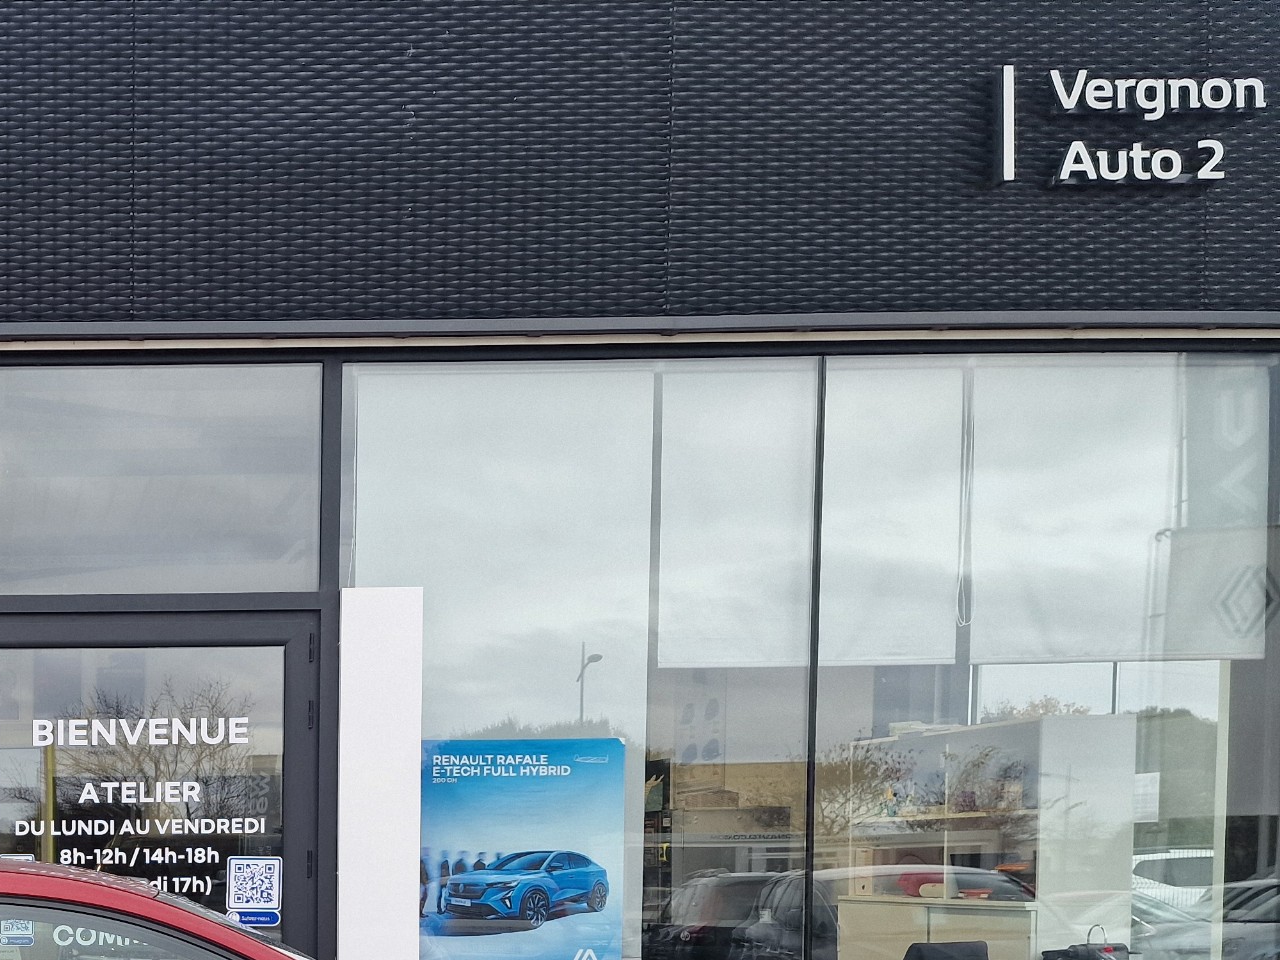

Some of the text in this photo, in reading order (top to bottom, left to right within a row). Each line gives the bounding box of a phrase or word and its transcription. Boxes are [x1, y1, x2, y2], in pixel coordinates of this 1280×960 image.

[1049, 69, 1267, 121] Vergnon
[1059, 139, 1225, 181] Auto 2
[31, 716, 249, 747] BIENVENUE
[432, 754, 549, 766] RENAULT RAFALE
[432, 765, 571, 777] E-TECH FULL HYBRID
[78, 781, 201, 804] ATELIER
[14, 817, 265, 837] DU LUNDI AU VENDREDI
[59, 847, 127, 865] 8h-12h
[142, 847, 220, 864] 14h-18h
[172, 875, 212, 896] 17h)
